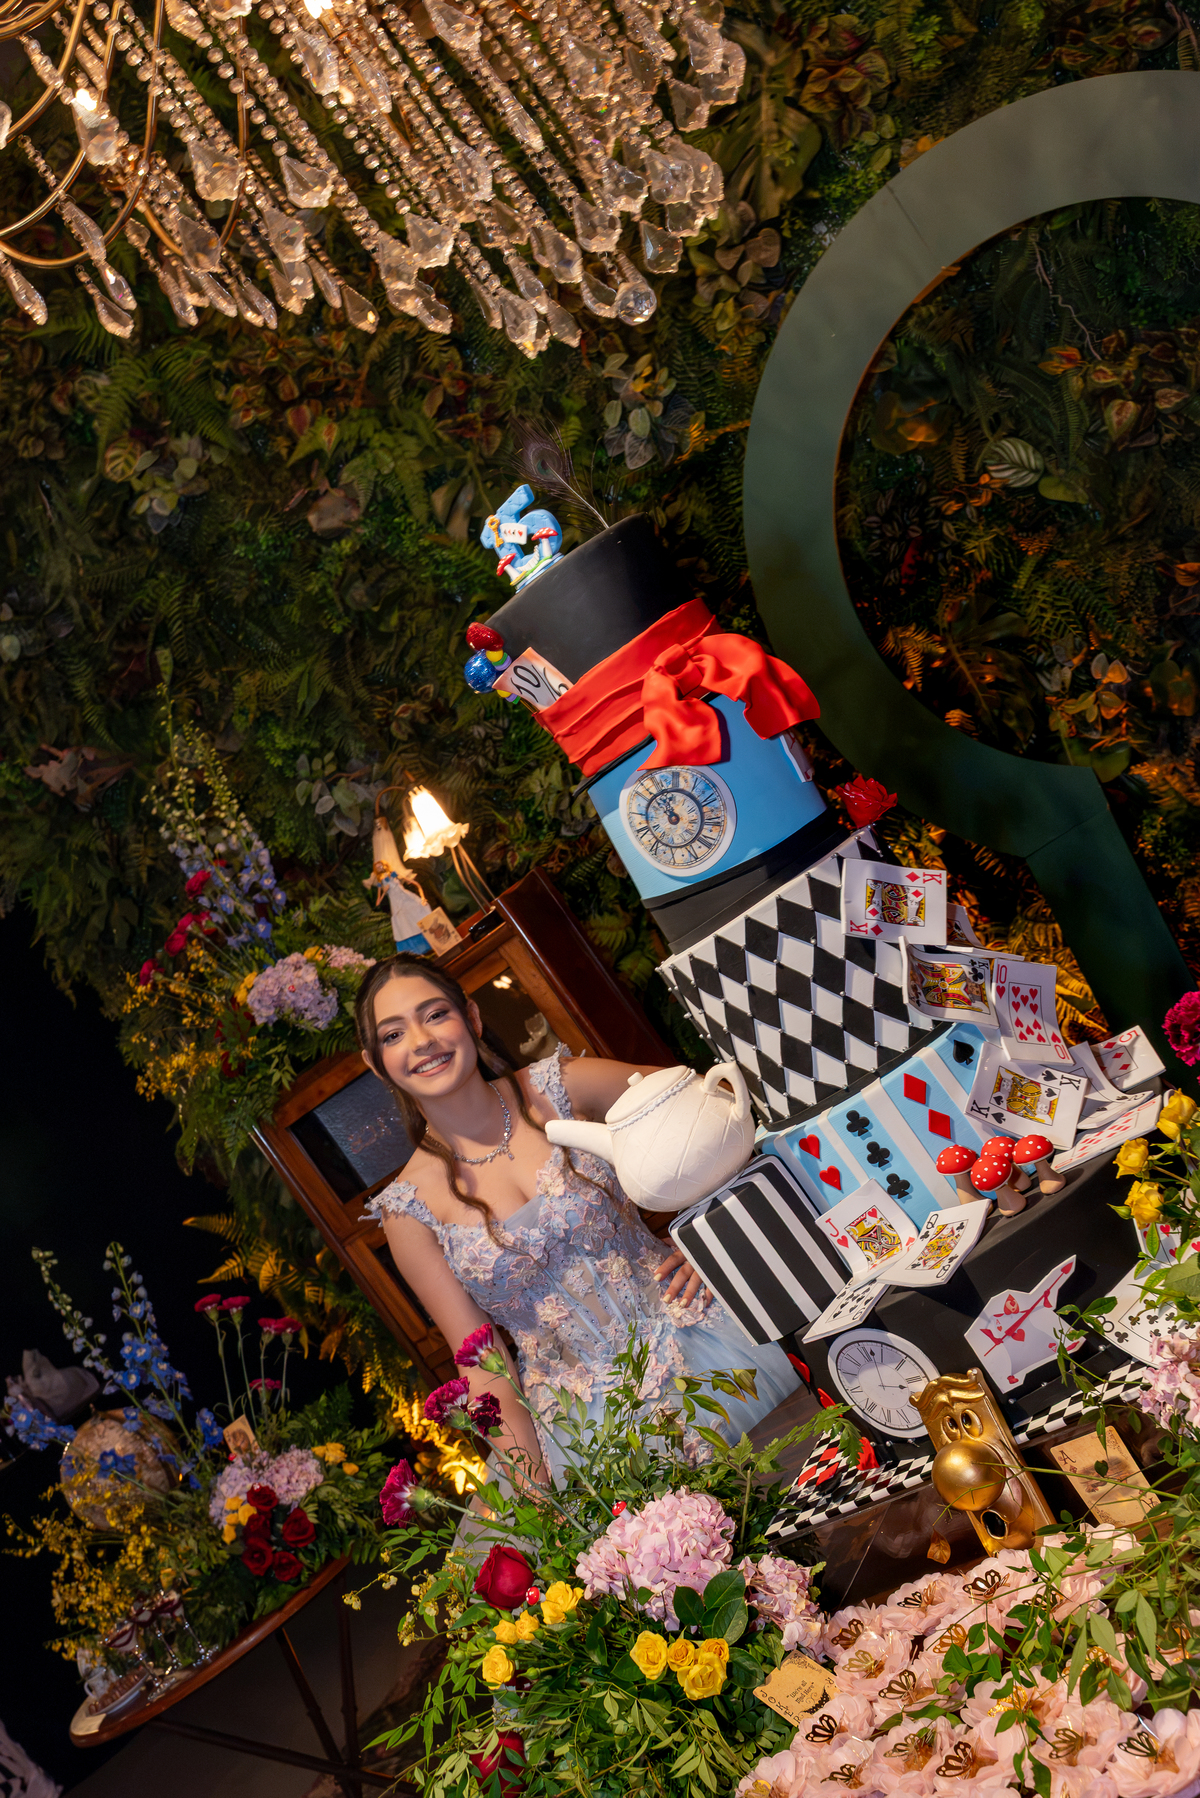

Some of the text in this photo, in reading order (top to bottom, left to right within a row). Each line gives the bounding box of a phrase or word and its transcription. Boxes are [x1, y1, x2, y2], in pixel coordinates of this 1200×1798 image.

[923, 872, 942, 885] K
[850, 920, 868, 935] K
[996, 964, 1008, 984] 10
[1119, 1030, 1139, 1043] 5
[1054, 1044, 1070, 1061] 10
[1060, 1075, 1081, 1091] K
[970, 1100, 990, 1118] K
[825, 1218, 840, 1238] J
[926, 1213, 939, 1229] Q
[936, 1264, 950, 1278] Q
[1097, 1315, 1115, 1333] 8
[1058, 1450, 1076, 1465] A
